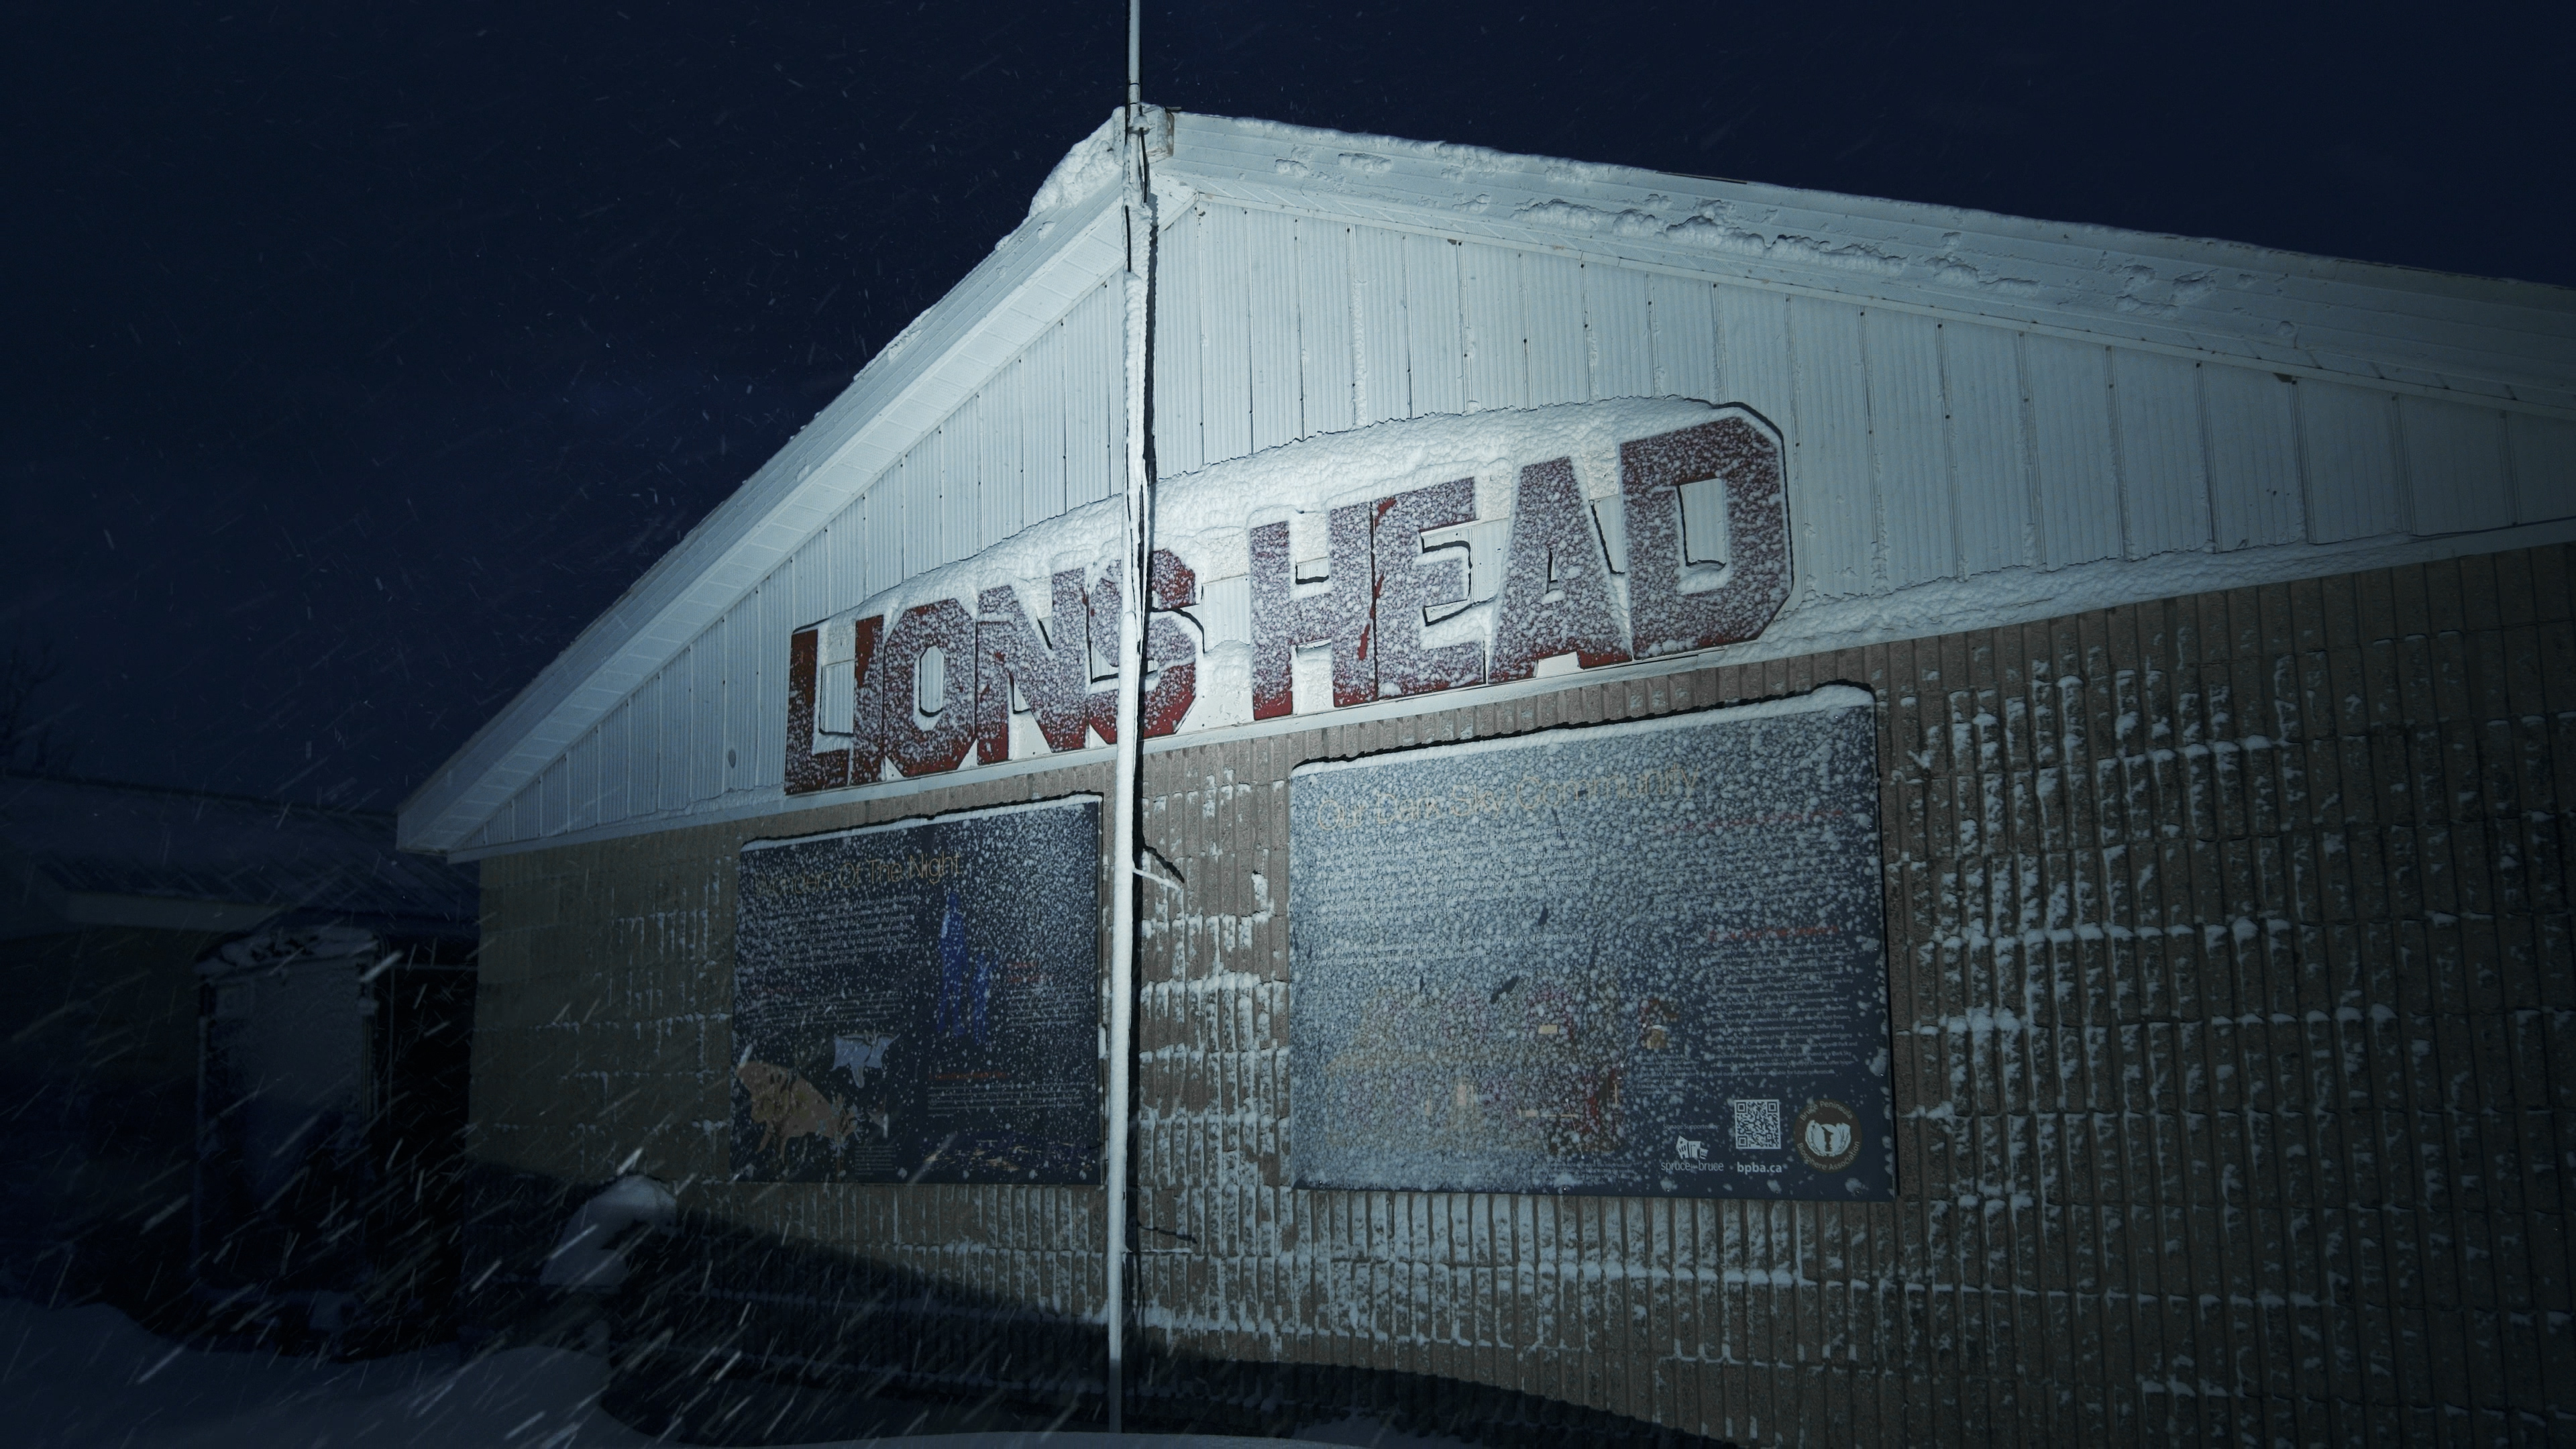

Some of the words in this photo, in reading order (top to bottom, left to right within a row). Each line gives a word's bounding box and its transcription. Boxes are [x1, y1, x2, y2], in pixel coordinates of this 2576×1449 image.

[784, 547, 1199, 796] LIONS
[1249, 413, 1794, 721] HEAD
[1316, 798, 1368, 831] Our
[1374, 788, 1444, 826] Dark
[1449, 782, 1505, 820] Sky
[1516, 765, 1701, 810] Community
[839, 859, 863, 890] Of
[865, 857, 904, 883] The
[908, 851, 963, 885] Night
[1799, 1104, 1819, 1122] Bruce
[1819, 1100, 1854, 1120] Peninsula
[1684, 1122, 1711, 1131] Supported
[1660, 1161, 1690, 1172] spruce
[1698, 1160, 1724, 1171] bruce
[1737, 1161, 1783, 1175] bpba.ca
[1797, 1142, 1827, 1171] Biosphere
[1828, 1141, 1861, 1171] Association
